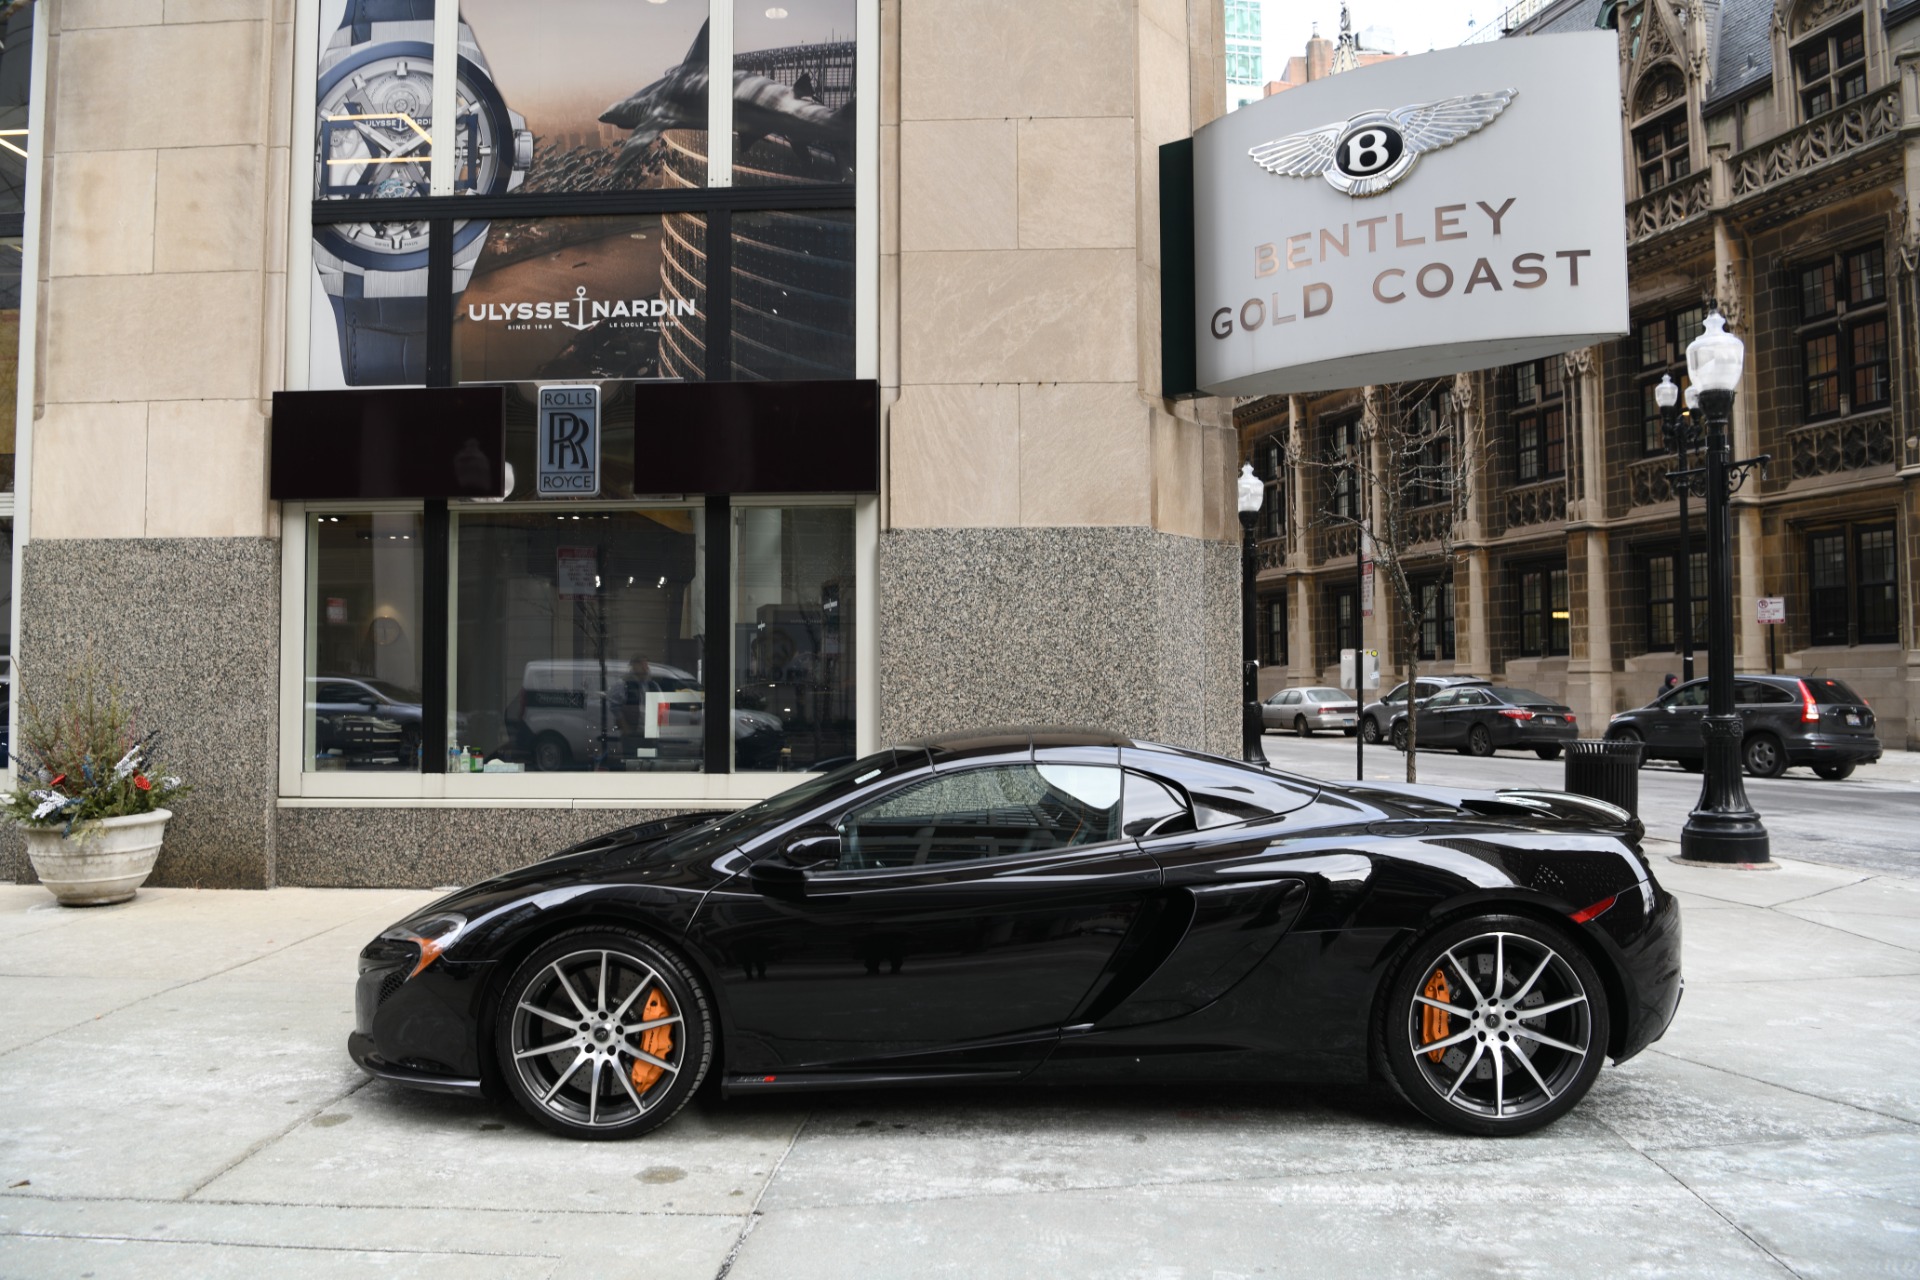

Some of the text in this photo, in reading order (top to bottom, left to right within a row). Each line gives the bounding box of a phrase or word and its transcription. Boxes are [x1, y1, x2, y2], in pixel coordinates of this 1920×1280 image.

[1347, 128, 1390, 173] B
[1254, 197, 1517, 279] BENTLEY
[468, 299, 696, 321] ULYSSE NARDIN
[1210, 249, 1591, 340] GOLD COAST
[544, 392, 592, 406] ROLLS
[543, 475, 591, 489] ROYCE
